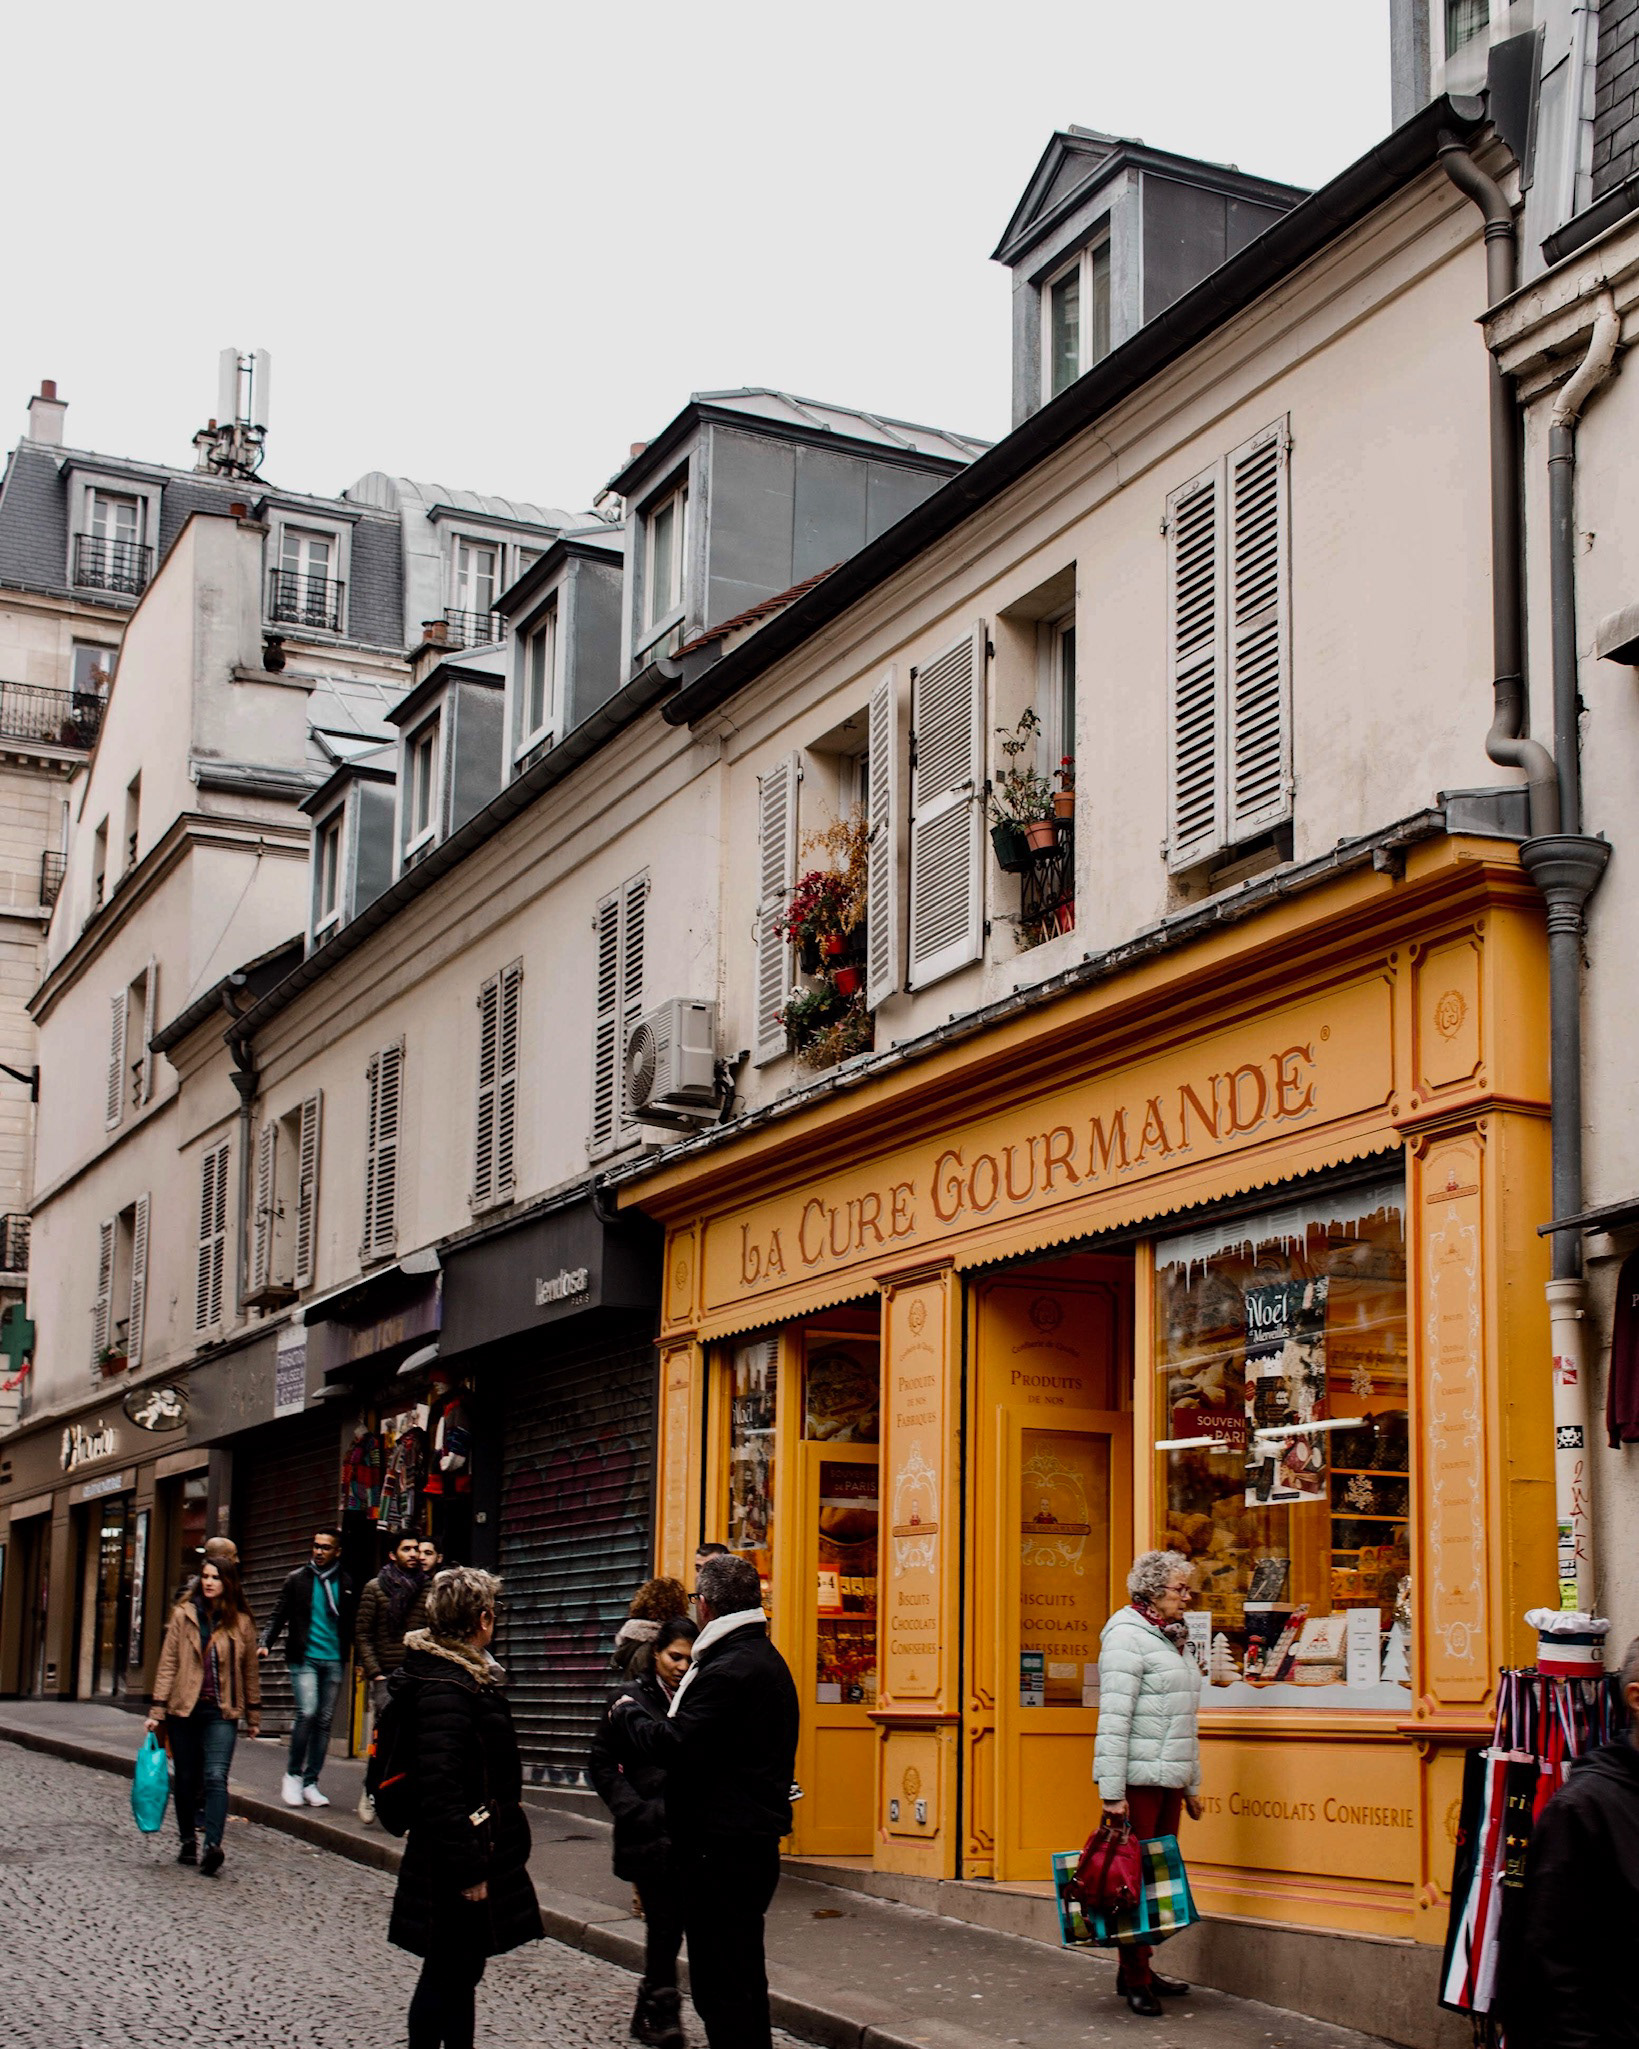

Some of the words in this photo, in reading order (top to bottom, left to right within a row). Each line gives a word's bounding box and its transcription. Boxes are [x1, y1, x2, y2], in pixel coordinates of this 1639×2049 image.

[739, 1222, 787, 1285] LA
[799, 1179, 916, 1266] CURE
[929, 1041, 1314, 1222] GOURMANDE
[1245, 1290, 1289, 1328] Noël
[1010, 1370, 1083, 1390] PRODUITS
[1028, 1395, 1041, 1404] DE
[1044, 1396, 1064, 1405] NOS
[898, 1591, 930, 1606] BISCUITS
[891, 1615, 936, 1631] CHOCOLATS
[1020, 1618, 1088, 1631] OCOLATS
[890, 1639, 936, 1655] CONFISERIES
[1020, 1643, 1088, 1656] NFISERIES
[1229, 1792, 1316, 1821] CHOCOLATS
[1323, 1797, 1415, 1829] CONFISERIE
